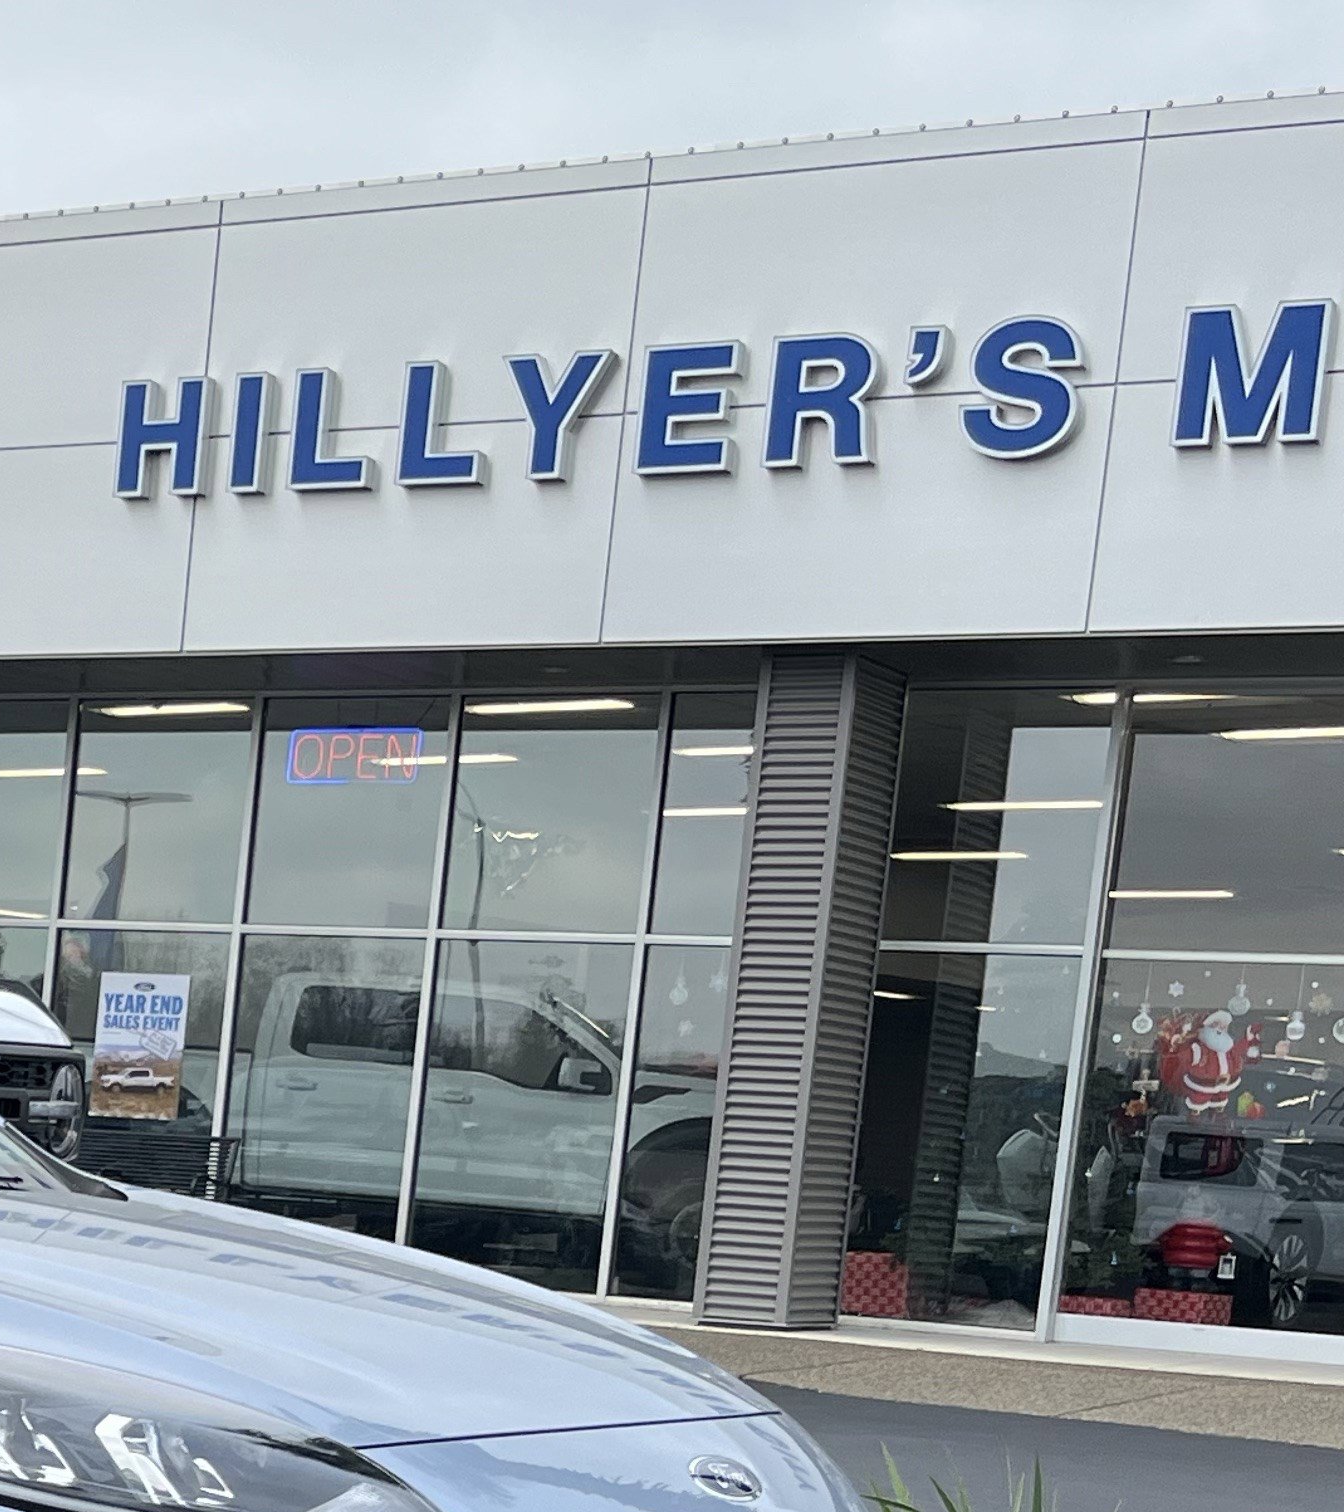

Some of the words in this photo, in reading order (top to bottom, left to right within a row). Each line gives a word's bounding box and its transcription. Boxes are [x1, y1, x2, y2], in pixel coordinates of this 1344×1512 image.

[115, 314, 1084, 498] HILLYER'S
[1170, 299, 1336, 449] M
[293, 733, 418, 780] OPEN
[104, 993, 147, 1014] YEAR
[149, 995, 184, 1015] END
[103, 1014, 140, 1031] SALES
[142, 1015, 181, 1032] EVENT
